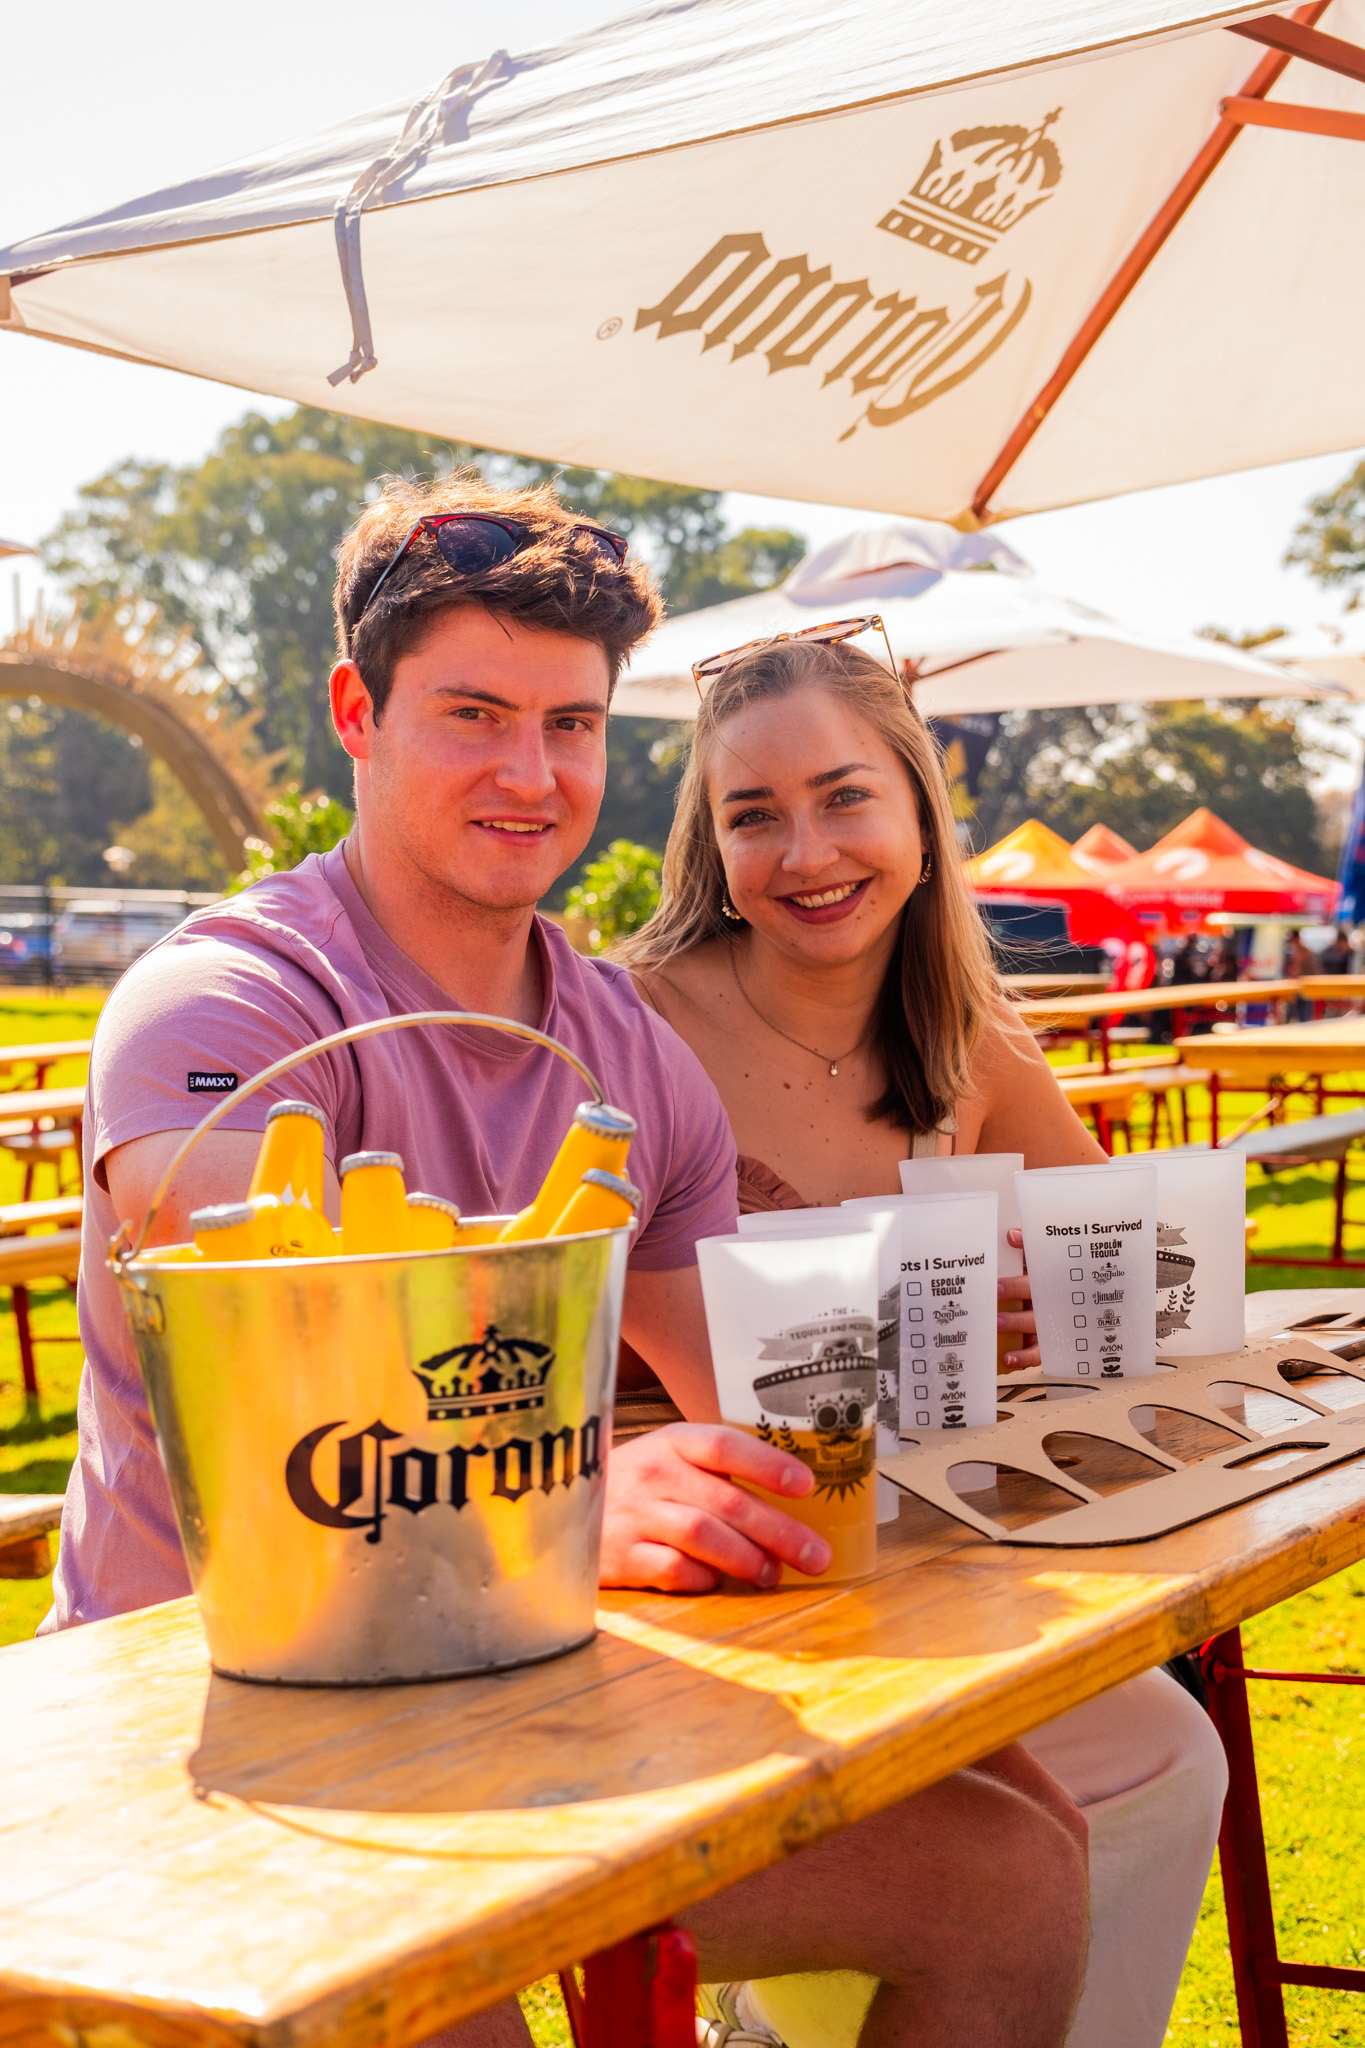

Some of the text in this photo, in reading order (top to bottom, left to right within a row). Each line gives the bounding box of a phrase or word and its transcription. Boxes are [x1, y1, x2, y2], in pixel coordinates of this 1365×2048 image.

[195, 1076, 235, 1087] MMXV
[1045, 1224, 1081, 1236] Shots
[1084, 1224, 1088, 1235] I
[1091, 1219, 1142, 1234] Survived
[1090, 1249, 1120, 1259] TEQUILA
[900, 1253, 985, 1272] ots I Survived
[931, 1286, 963, 1297] TEQUILA
[1094, 1289, 1124, 1305] Jimador
[831, 1307, 848, 1316] THE
[1097, 1318, 1121, 1327] OLMECA
[789, 1326, 828, 1340] TEQUILA
[829, 1323, 847, 1333] AND
[935, 1330, 968, 1348] Jimador
[285, 1416, 601, 1544] Corona
